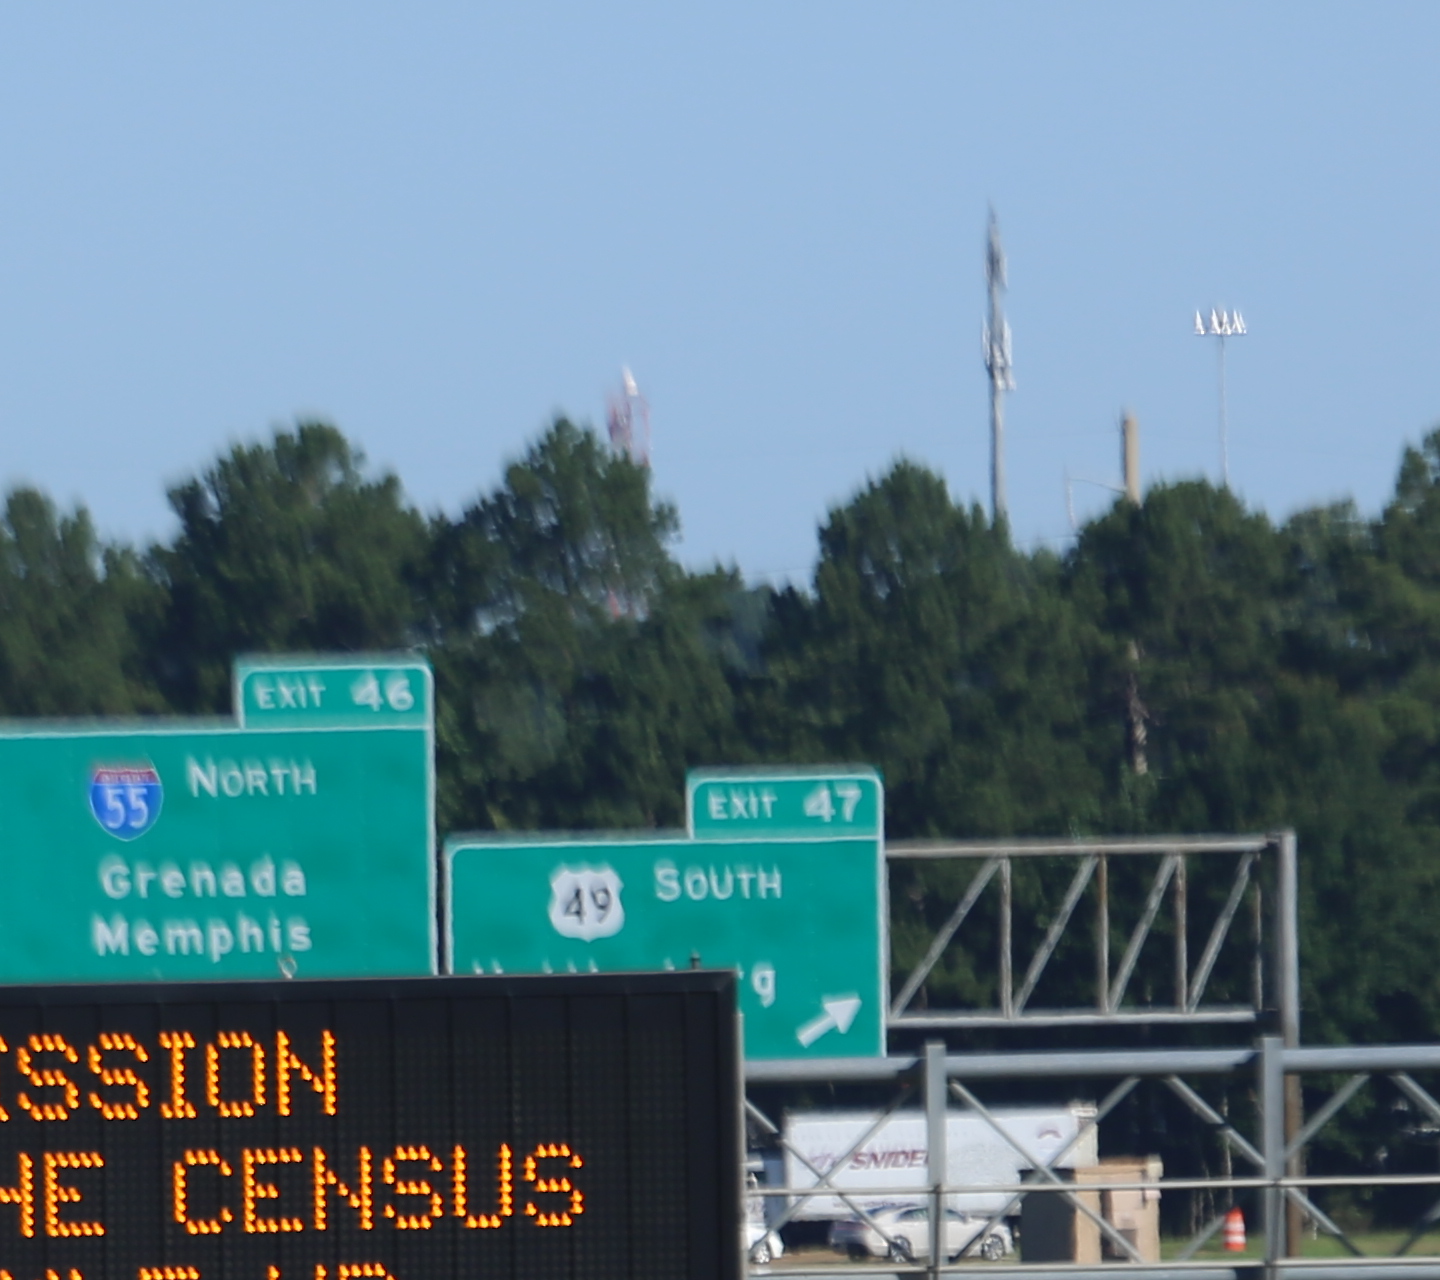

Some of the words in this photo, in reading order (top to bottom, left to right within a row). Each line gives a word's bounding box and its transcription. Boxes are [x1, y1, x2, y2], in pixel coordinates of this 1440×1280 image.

[257, 681, 325, 711] EXIT
[354, 674, 414, 713] 46
[104, 786, 148, 829] 55
[188, 755, 317, 798] NORTH
[709, 788, 777, 820] EXIT
[804, 783, 862, 823] 47
[101, 856, 307, 902] Grenada
[563, 887, 612, 925] 49
[654, 862, 782, 901] SOUTH
[94, 914, 313, 962] Memphis
[849, 1150, 929, 1171] SNIDE
[173, 1143, 584, 1235] CENSUS
